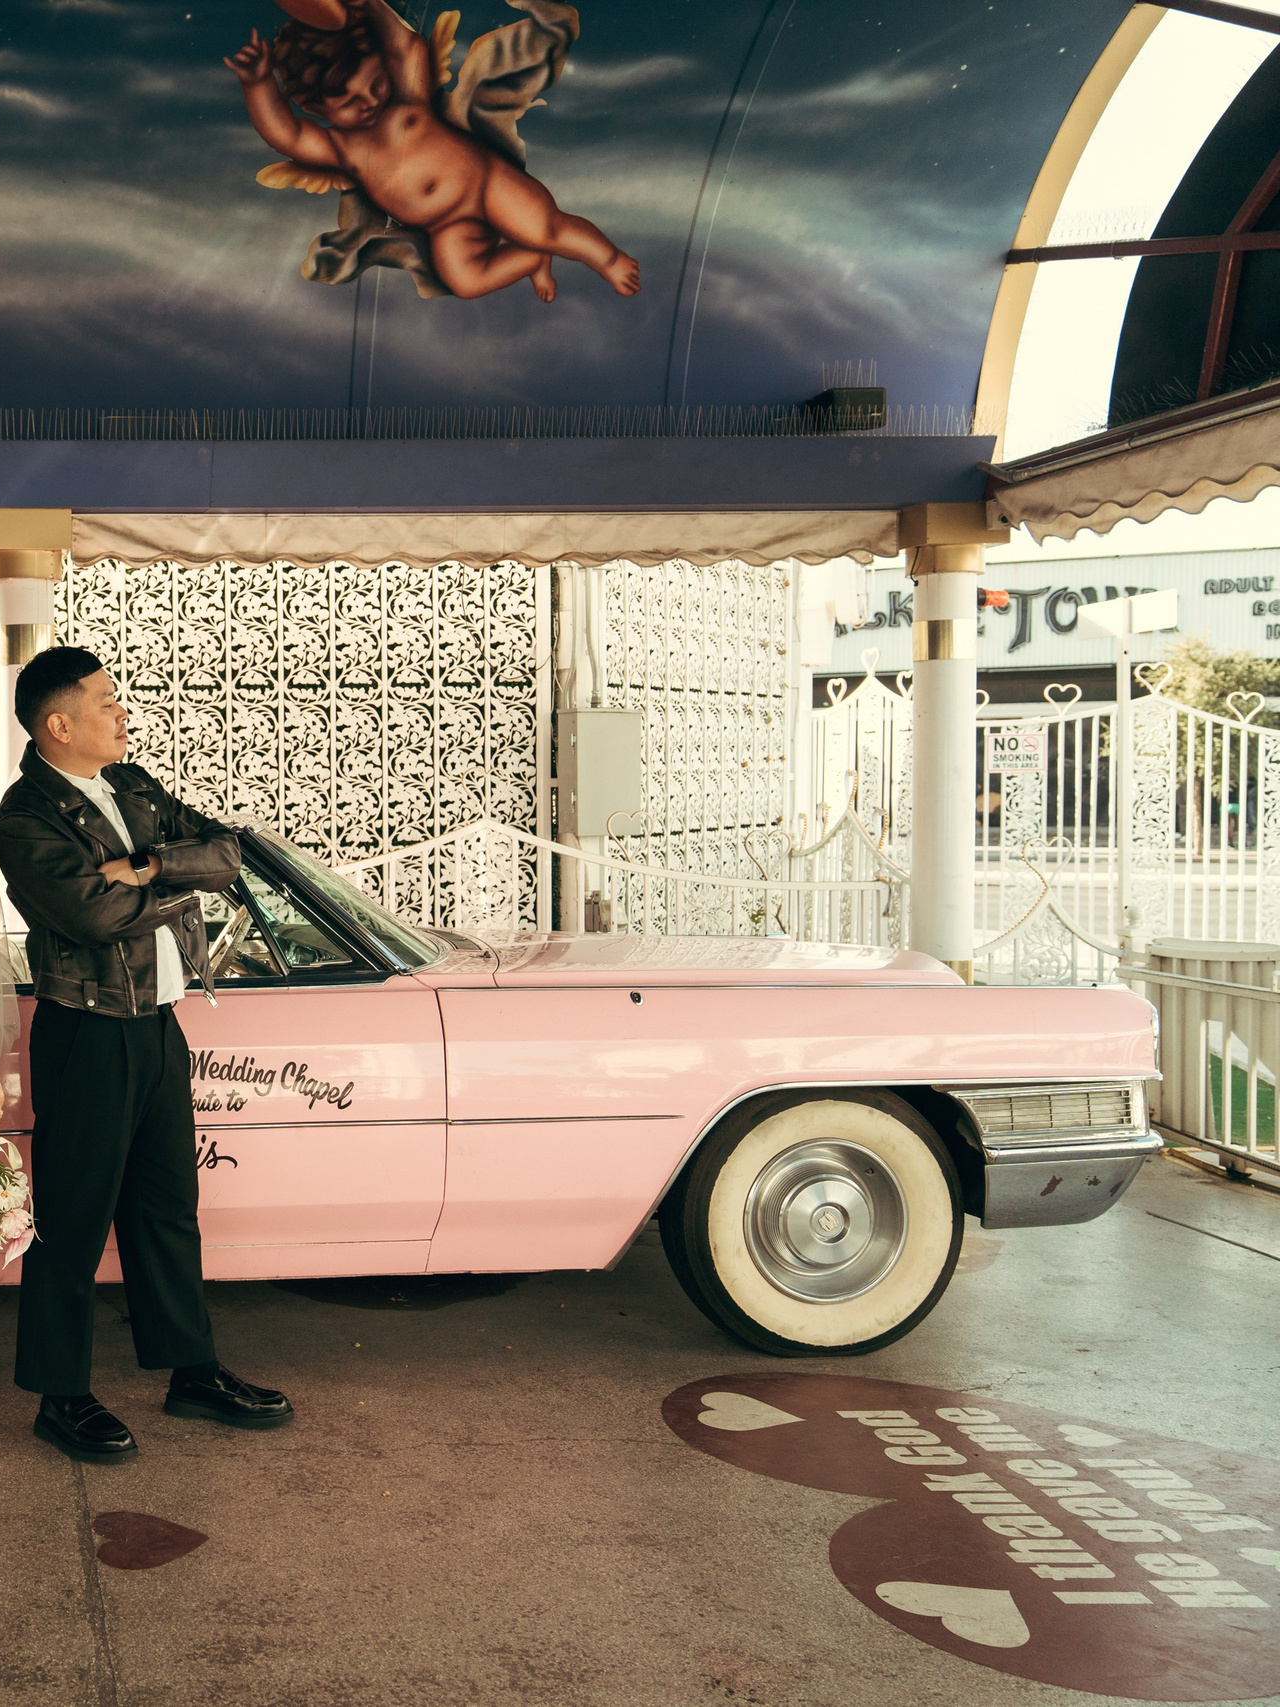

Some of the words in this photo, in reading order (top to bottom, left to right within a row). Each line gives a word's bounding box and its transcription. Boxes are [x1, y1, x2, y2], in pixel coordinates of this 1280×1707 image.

[1204, 576, 1275, 595] ADULT
[993, 753, 1040, 762] SMOKING
[994, 737, 1019, 751] NO
[189, 1050, 277, 1097] Wedding
[280, 1061, 355, 1110] Chapel
[226, 1088, 249, 1112] to
[836, 1410, 968, 1466] God
[935, 1407, 1046, 1452] me
[1005, 1459, 1182, 1543] gave
[922, 1472, 1116, 1581] thank
[1052, 1591, 1154, 1604] I
[1133, 1552, 1272, 1608] He
